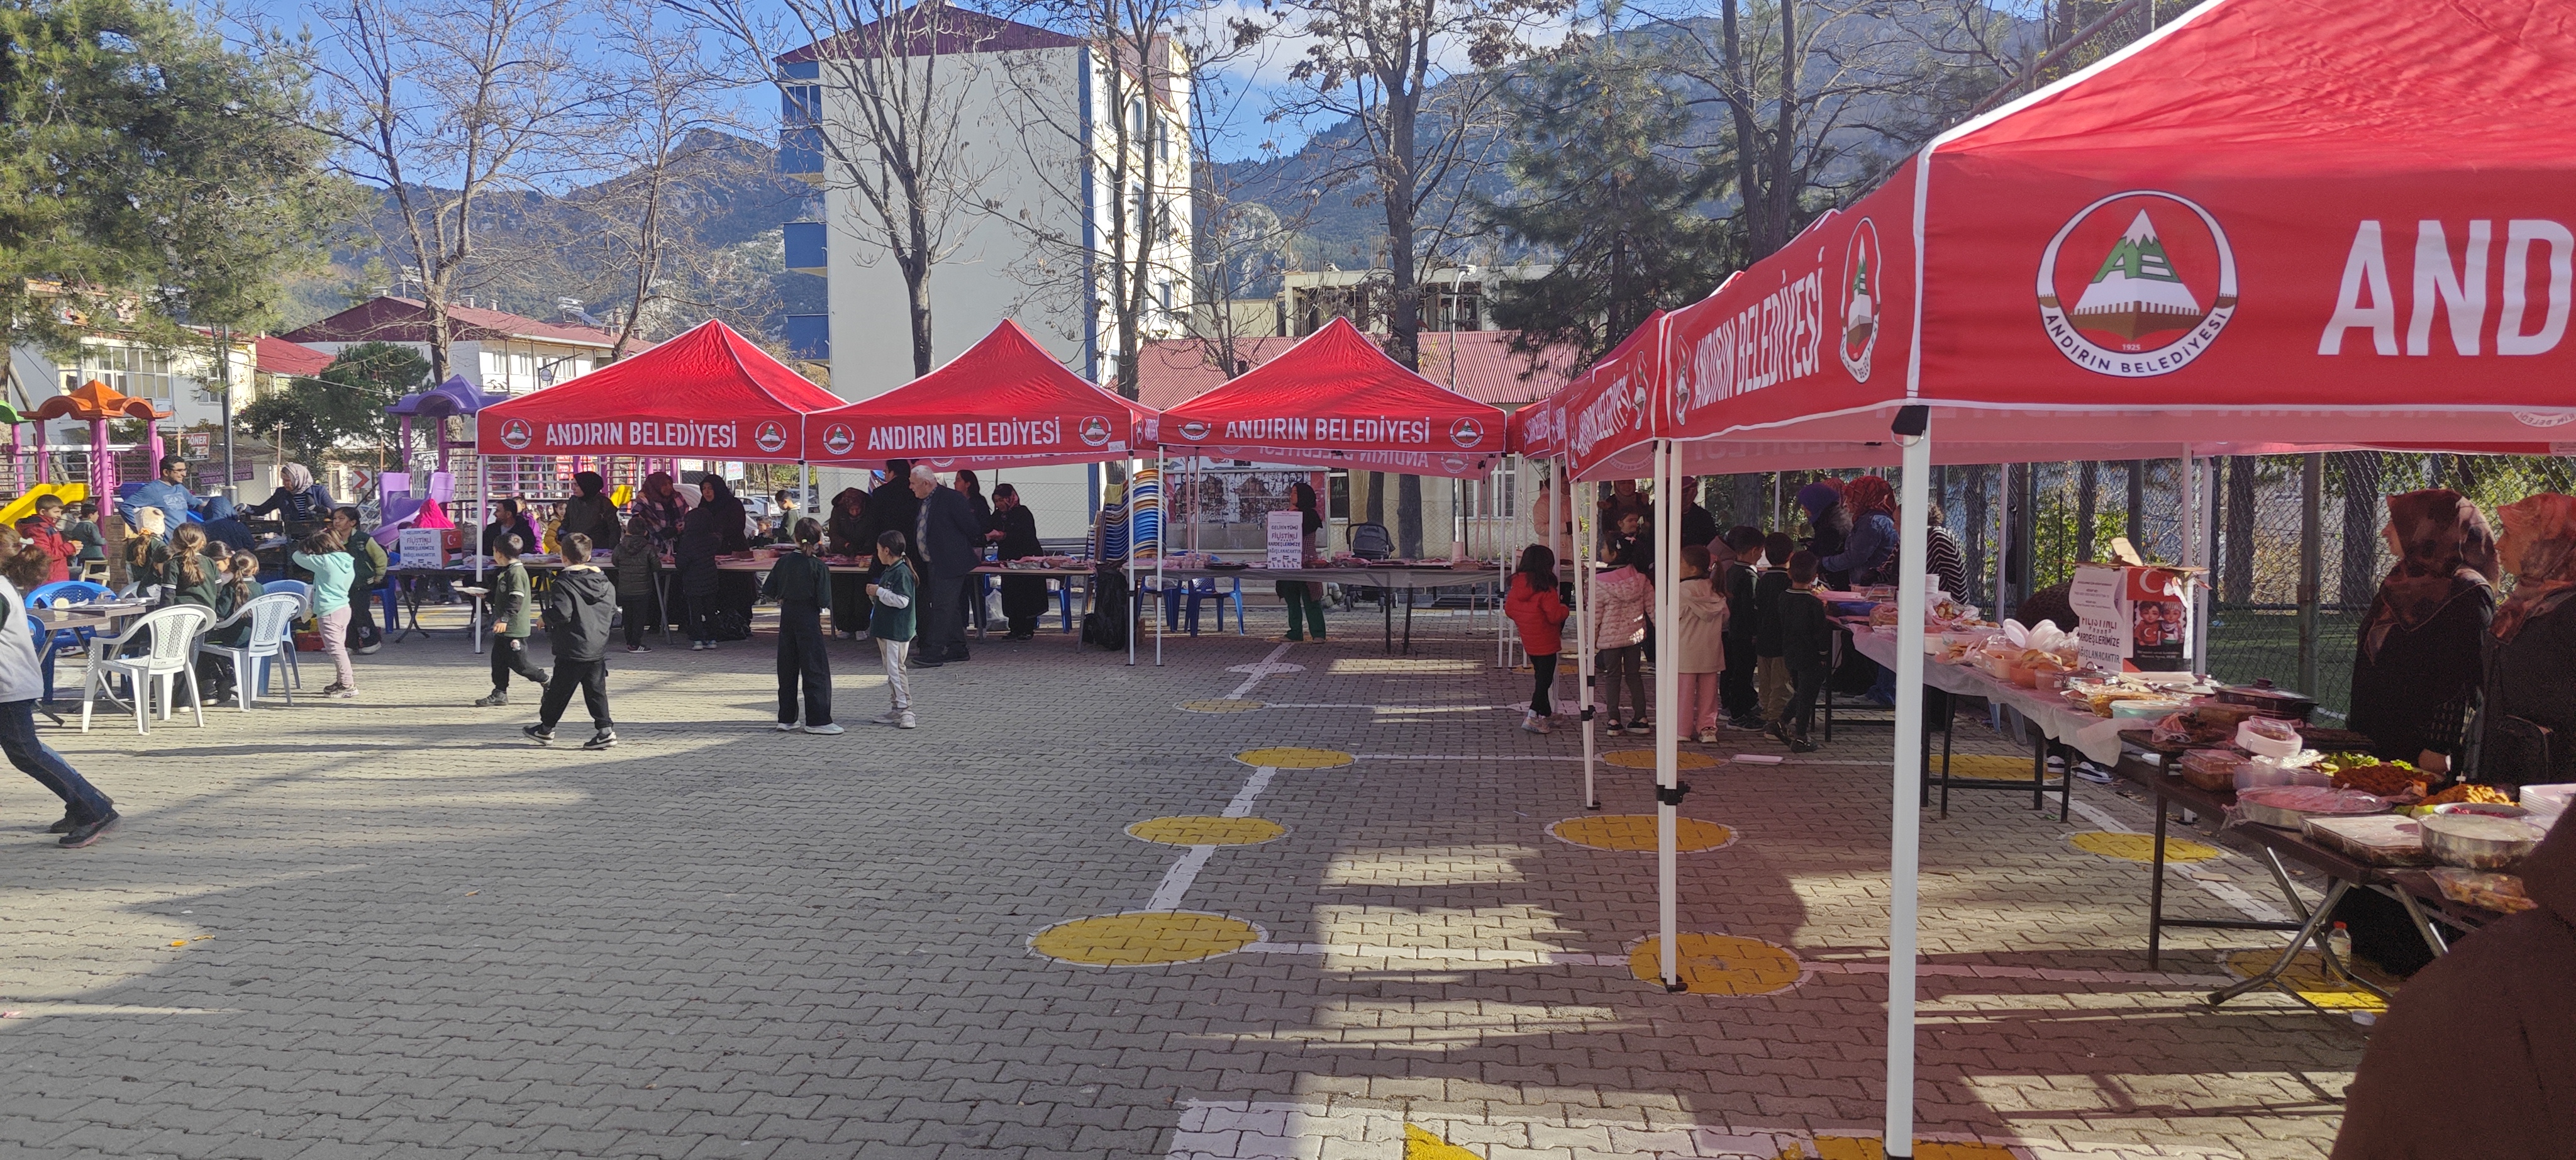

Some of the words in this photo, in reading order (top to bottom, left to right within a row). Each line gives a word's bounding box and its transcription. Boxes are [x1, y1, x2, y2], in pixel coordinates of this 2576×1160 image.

[2317, 219, 2575, 356] AND
[1692, 316, 1736, 411] ANDIRIN
[1736, 246, 1825, 396] BELEDİYESİ
[2045, 315, 2111, 371] ANDIRIN
[2121, 312, 2227, 373] BELEDİYESİ
[545, 421, 623, 446] ANDIRIN
[630, 419, 736, 448] BELEDİYESİ
[867, 424, 945, 450] ANDIRIN
[952, 416, 1060, 448] BELEDİYESİ
[1224, 417, 1307, 440] ANDIRIN
[1315, 415, 1430, 443] BELEDİYESİ
[2079, 632, 2120, 648] ARDEŞLERİMİZE
